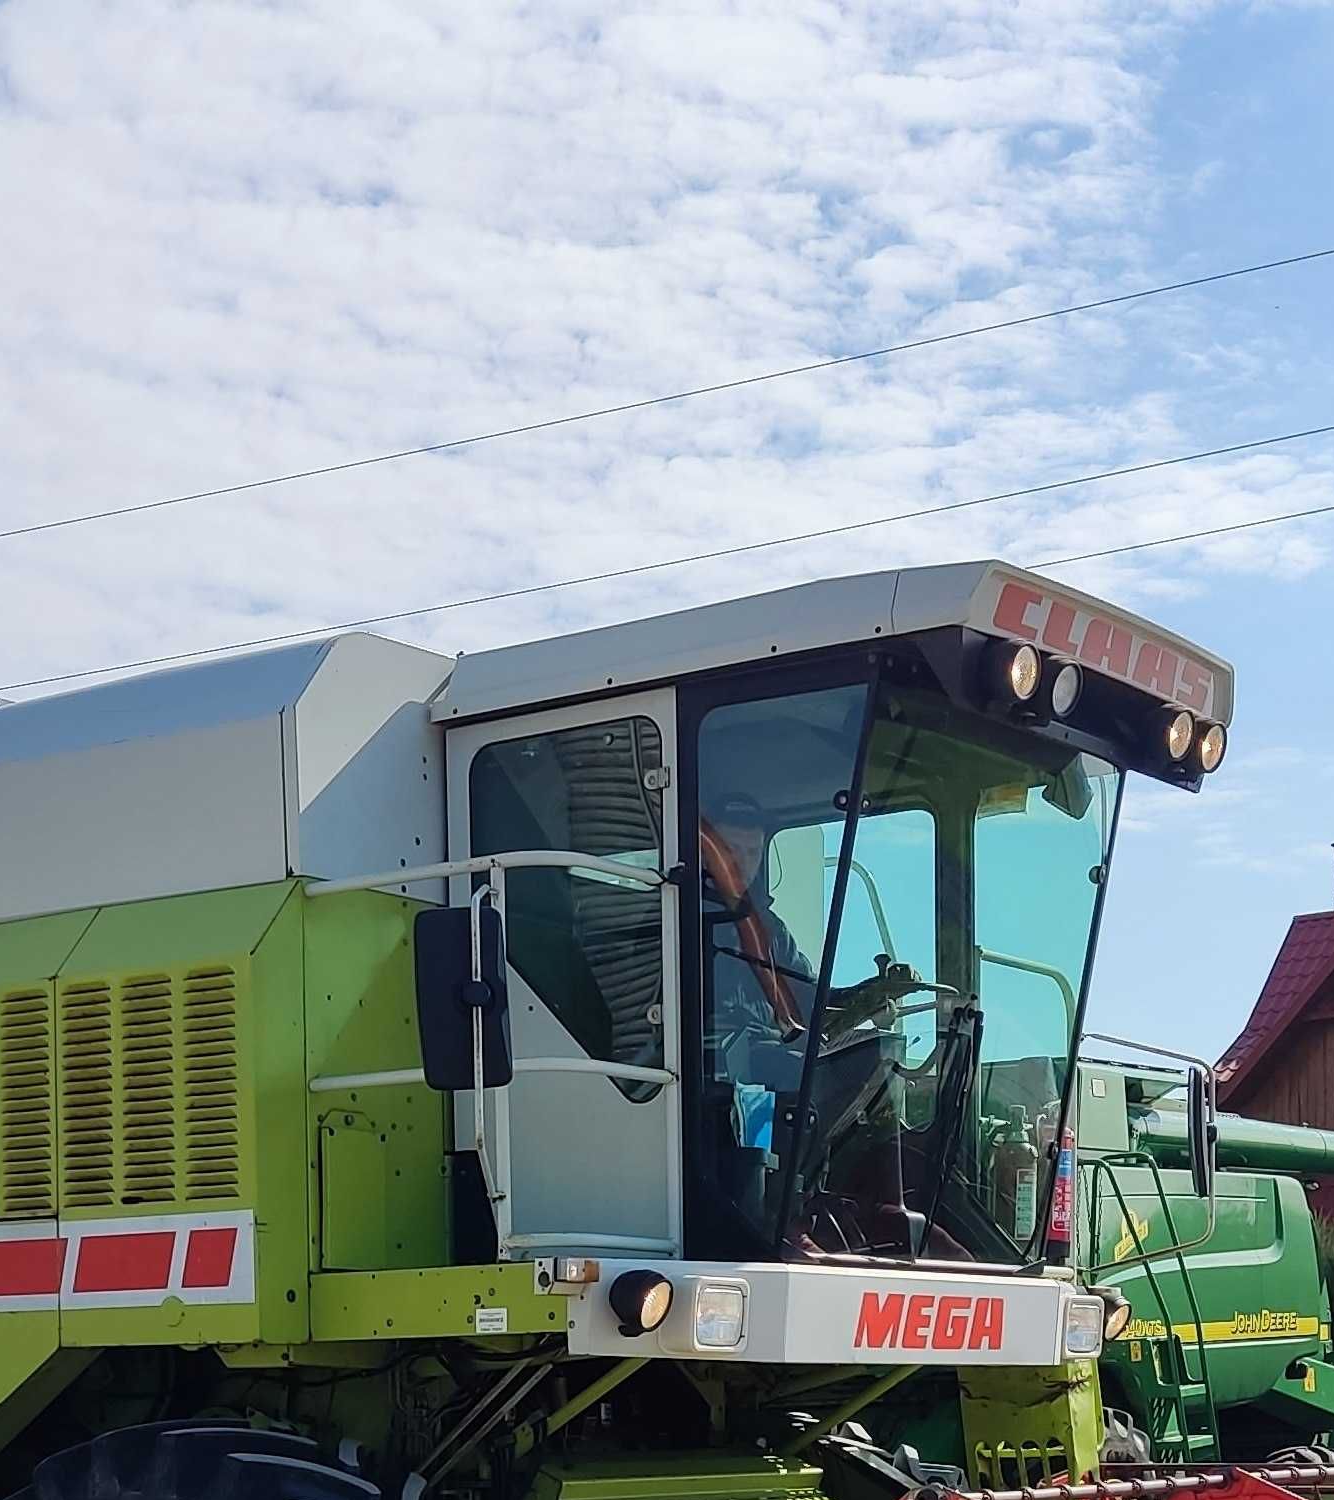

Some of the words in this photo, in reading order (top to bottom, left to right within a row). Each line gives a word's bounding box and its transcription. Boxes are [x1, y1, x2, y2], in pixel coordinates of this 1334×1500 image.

[992, 582, 1213, 713] CLAAS
[853, 1291, 1005, 1350] MEGA
[1230, 1310, 1261, 1335] JOHN
[1261, 1307, 1299, 1331] DEERE
